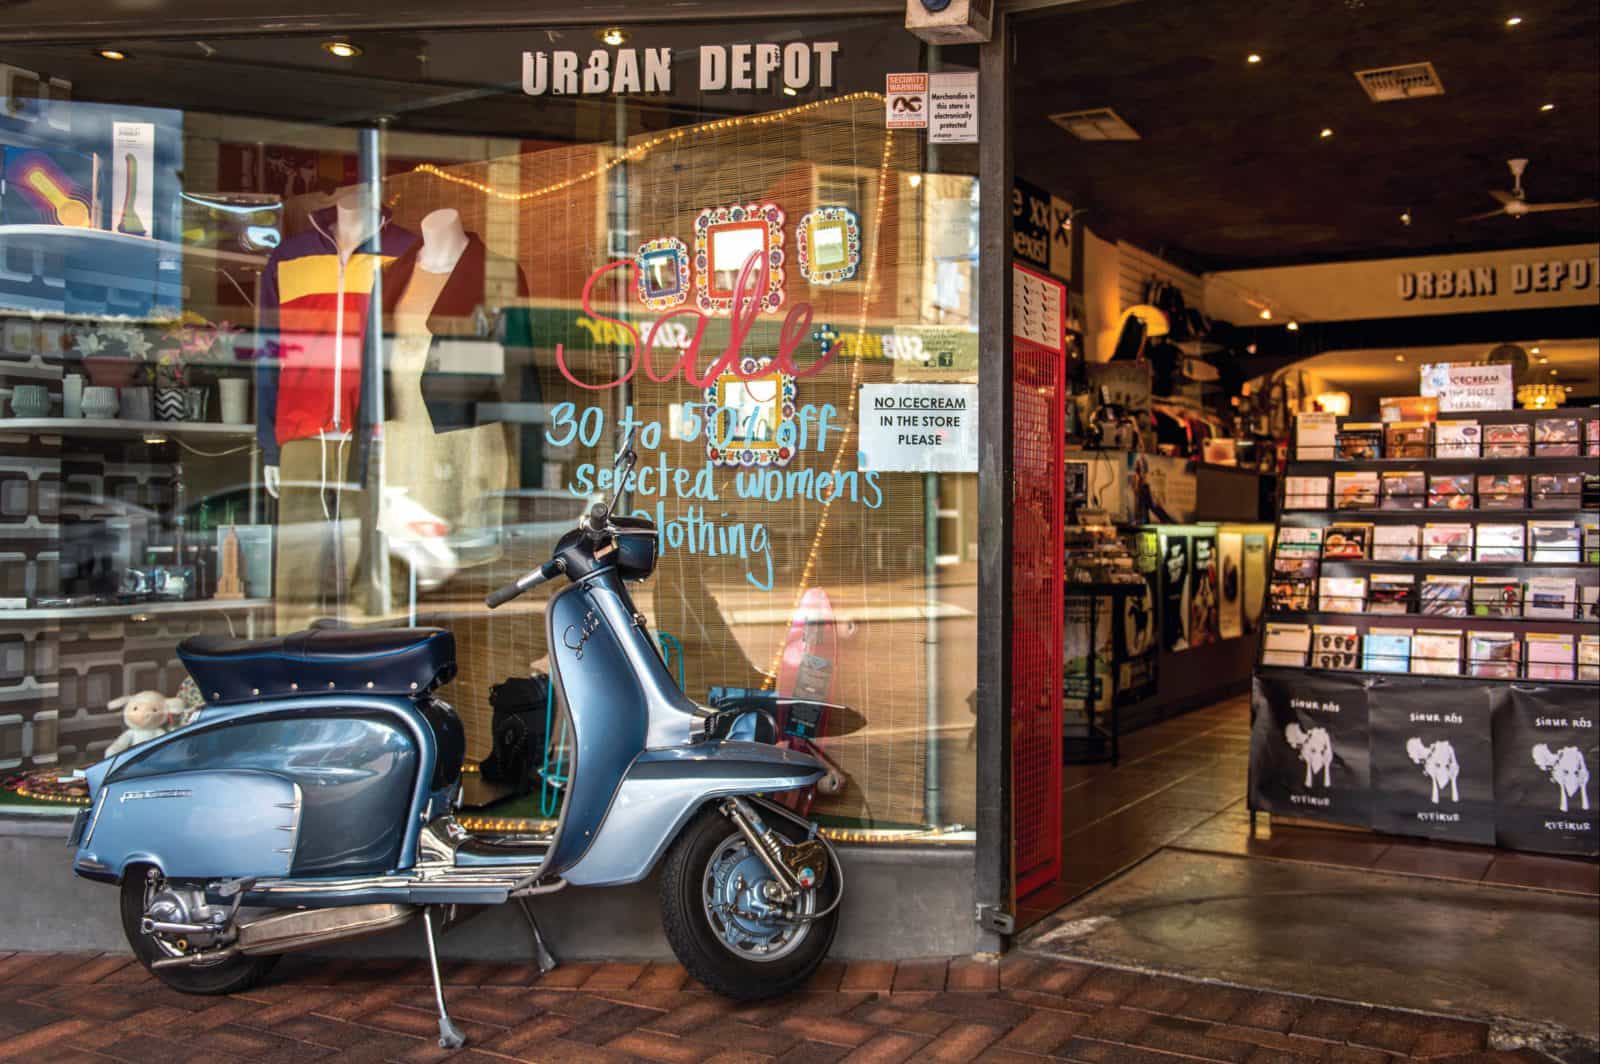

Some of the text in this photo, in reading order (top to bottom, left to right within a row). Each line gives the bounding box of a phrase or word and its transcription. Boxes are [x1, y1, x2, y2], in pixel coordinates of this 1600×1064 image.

[521, 41, 839, 96] URBAN DEPOT
[931, 92, 968, 100] Merchandise
[934, 111, 972, 120] electronically
[939, 121, 967, 129] protected
[1398, 267, 1497, 300] URBAN
[555, 249, 843, 391] Sale
[874, 397, 966, 409] NO ICECREAM
[545, 401, 604, 448] 30
[618, 403, 662, 450] to
[775, 403, 845, 452] off
[880, 416, 961, 427] IN THE STORE
[898, 434, 942, 446] PLEASE
